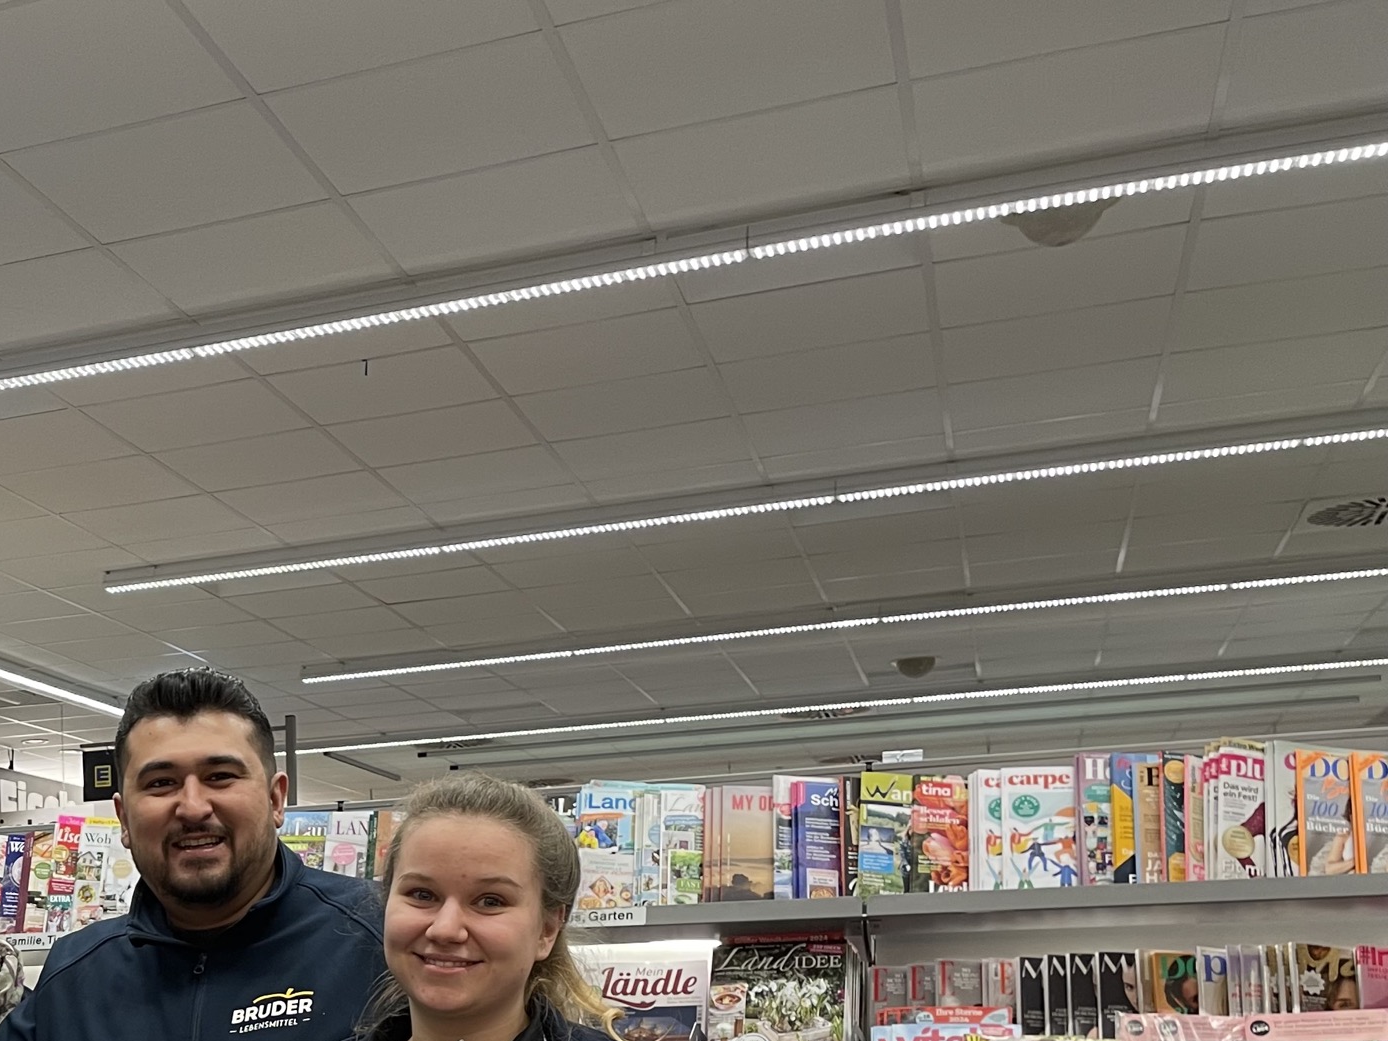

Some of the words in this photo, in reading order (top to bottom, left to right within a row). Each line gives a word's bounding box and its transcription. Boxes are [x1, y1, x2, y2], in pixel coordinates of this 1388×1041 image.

[1007, 774, 1070, 790] carpe
[1223, 782, 1237, 790] Das
[1239, 785, 1259, 794] wird
[922, 784, 951, 797] tina
[1223, 790, 1236, 799] ein
[1237, 792, 1258, 802] Fest!
[732, 794, 752, 809] MY
[1306, 821, 1349, 835] Bücher
[588, 911, 633, 922] Garten
[635, 967, 663, 977] Mein
[601, 966, 698, 1010] Ländle
[231, 998, 313, 1024] BRUDER
[239, 1018, 298, 1034] LEBENSMITTEL
